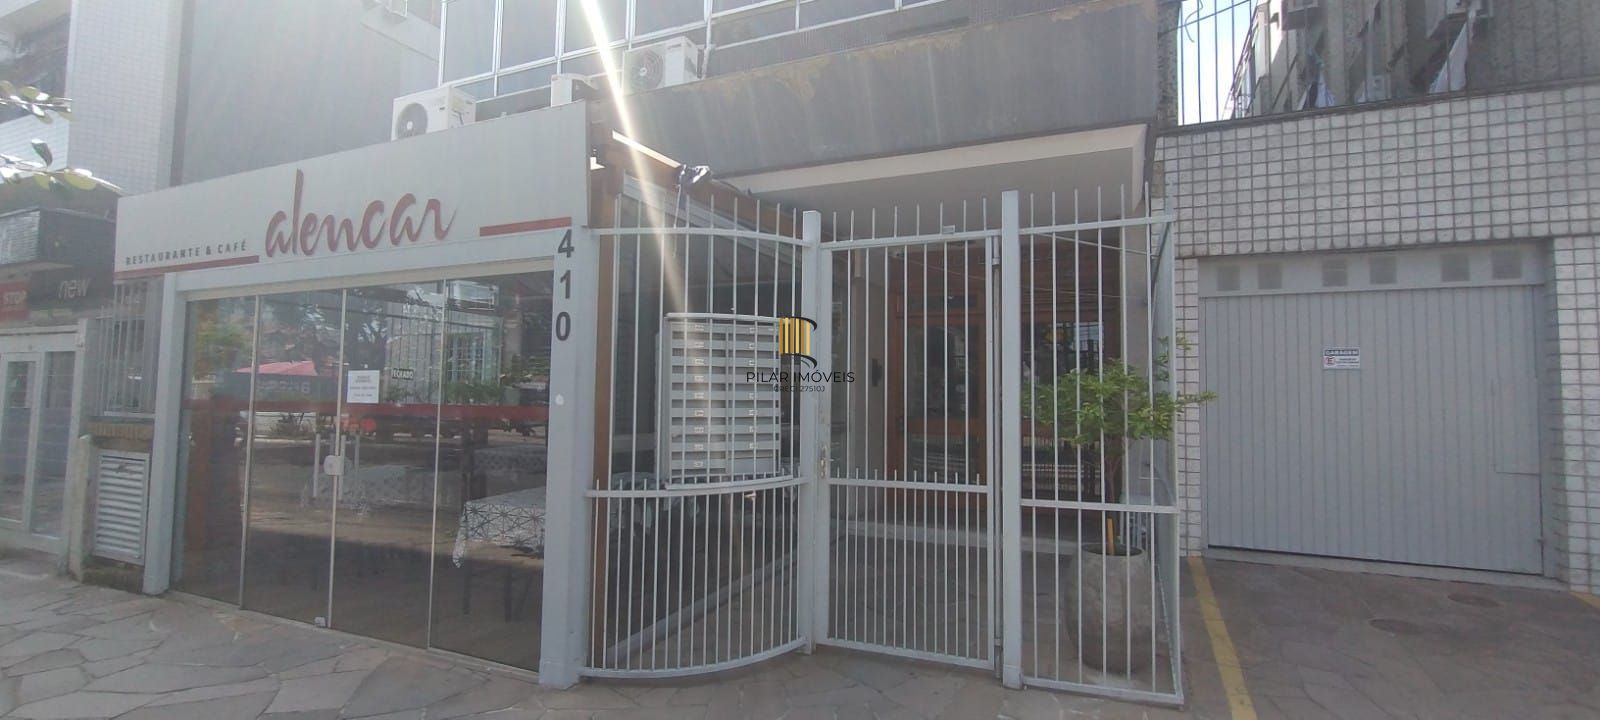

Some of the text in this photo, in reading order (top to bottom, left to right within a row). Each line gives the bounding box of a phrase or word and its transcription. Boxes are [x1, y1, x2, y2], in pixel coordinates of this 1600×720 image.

[126, 240, 246, 265] RESTAURANTE & CAFÉ
[265, 168, 457, 257] alencar
[556, 229, 574, 341] 410
